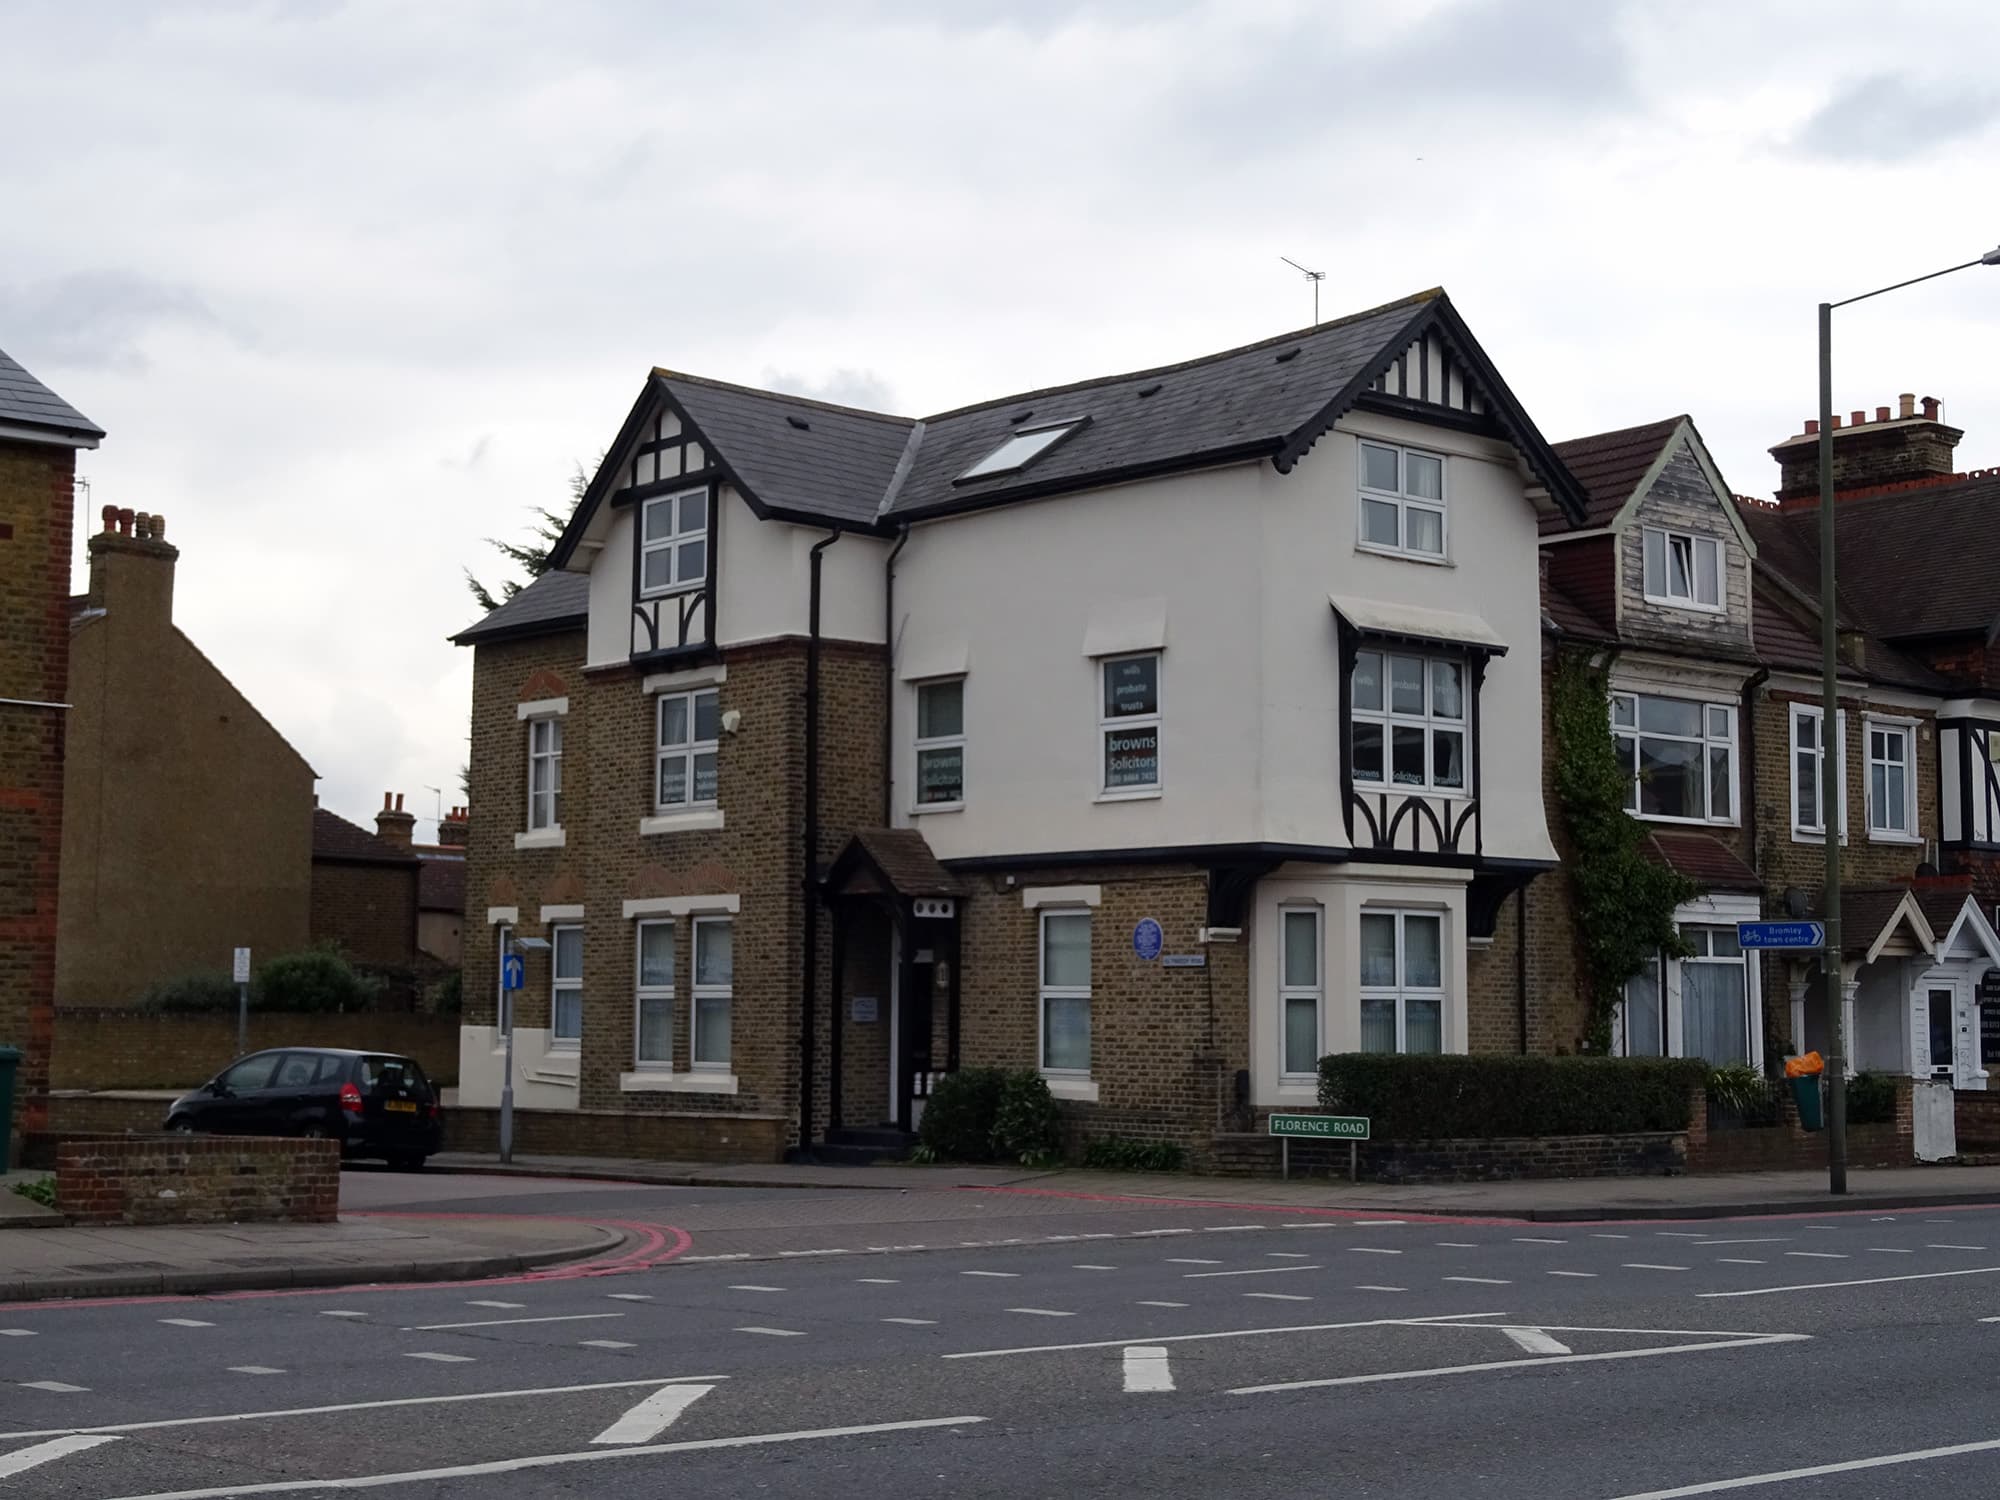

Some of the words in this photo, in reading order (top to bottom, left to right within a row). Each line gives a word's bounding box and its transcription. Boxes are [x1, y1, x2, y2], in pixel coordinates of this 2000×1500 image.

[1109, 736, 1157, 752] browns
[1110, 754, 1157, 771] Solicitors
[1769, 926, 1802, 935] Bromley
[1784, 935, 1809, 943] centre
[1274, 1120, 1329, 1132] FLORENCE
[1334, 1122, 1365, 1133] ROAD
